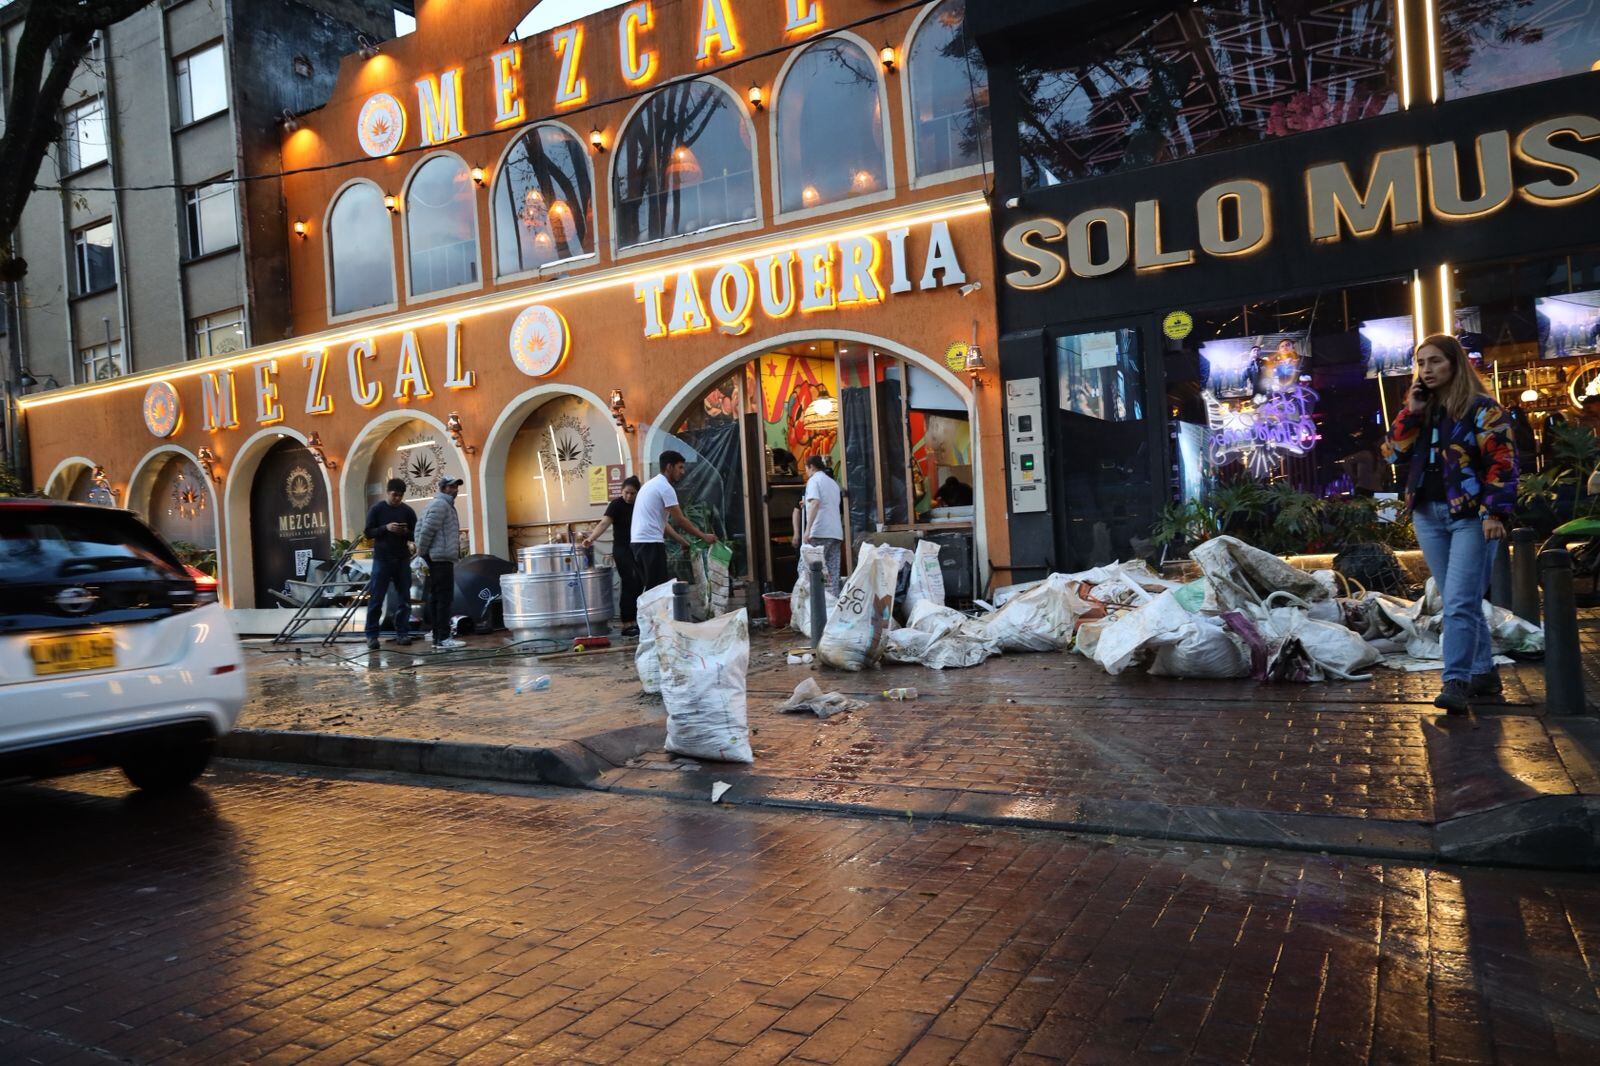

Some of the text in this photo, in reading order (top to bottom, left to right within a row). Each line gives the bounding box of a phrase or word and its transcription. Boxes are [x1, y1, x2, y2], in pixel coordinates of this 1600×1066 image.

[1003, 116, 1600, 290] SOLO MUS
[634, 221, 966, 337] TAQUERIA
[202, 320, 475, 430] MEZCAL
[279, 512, 327, 531] MEZCAL
